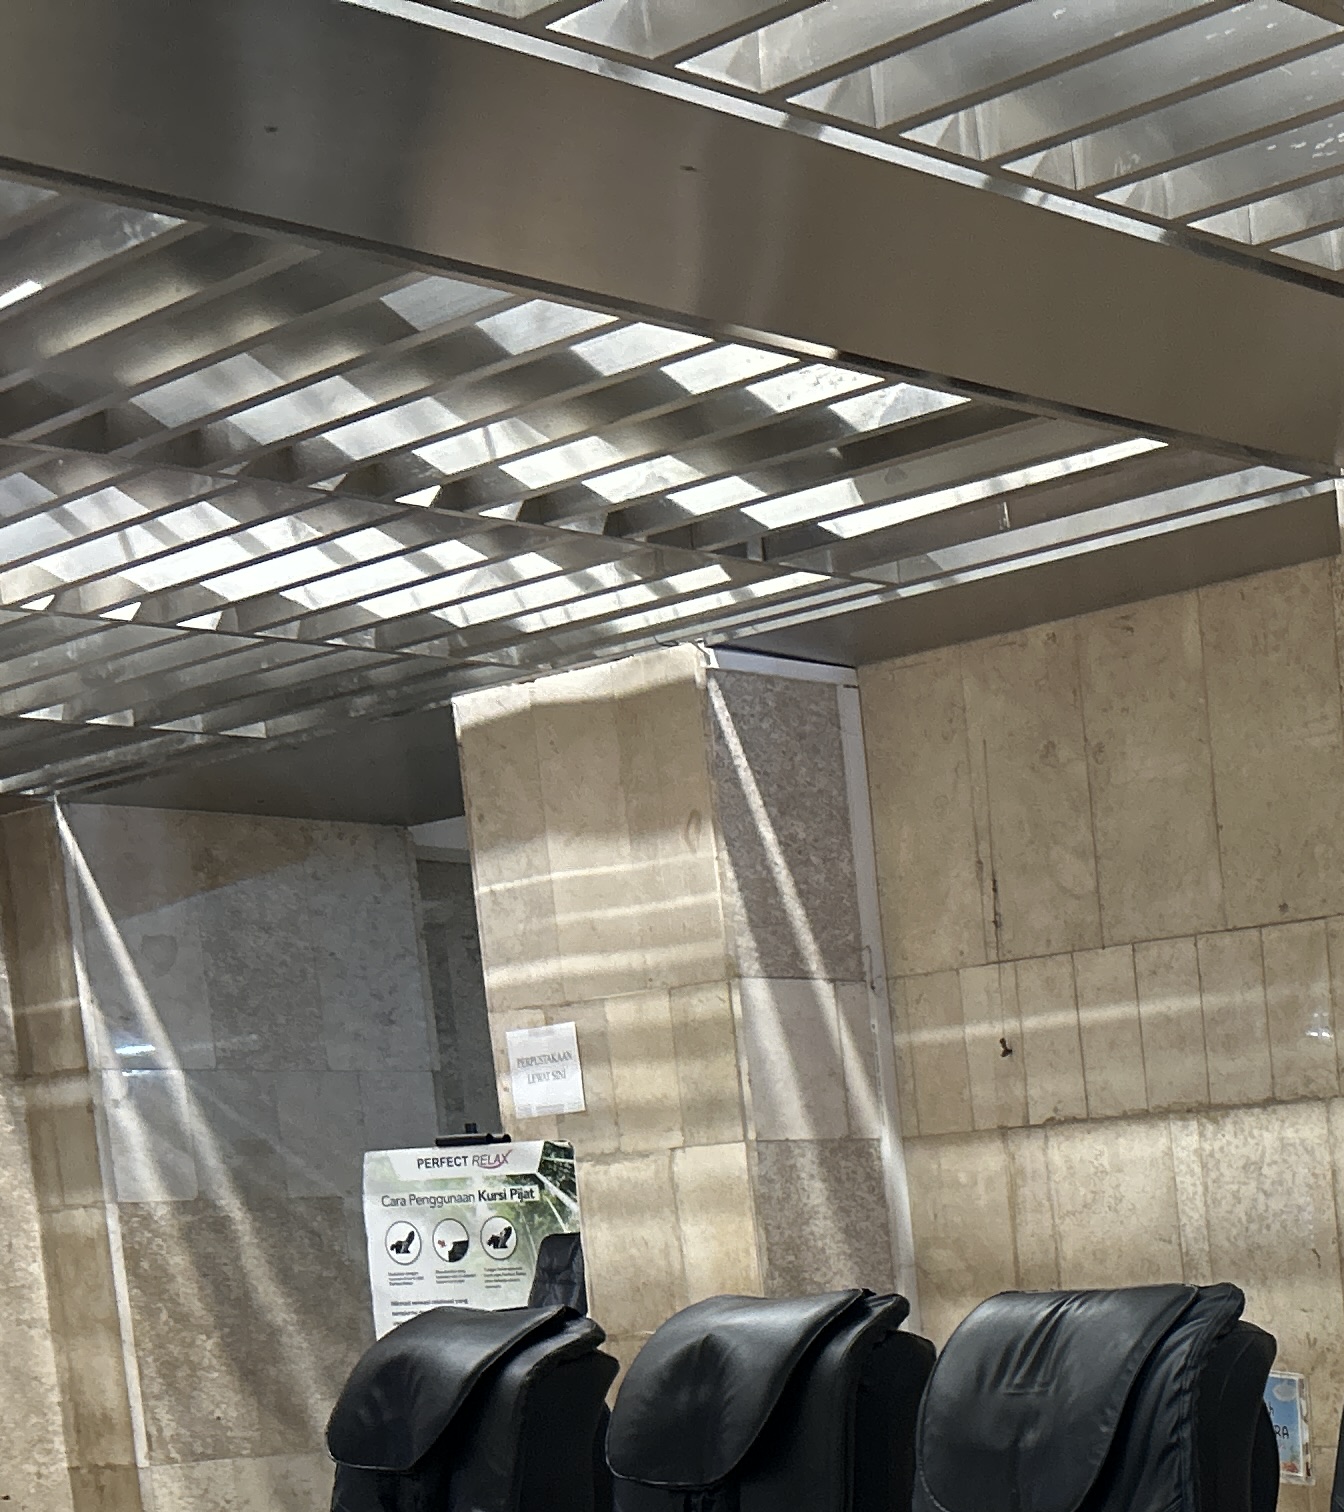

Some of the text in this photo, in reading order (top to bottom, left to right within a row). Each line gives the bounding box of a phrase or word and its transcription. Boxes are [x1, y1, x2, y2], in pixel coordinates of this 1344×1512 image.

[417, 1151, 511, 1169] PERFECT RELAX
[381, 1188, 535, 1208] Cara Penggunaan Kursi Pijat
